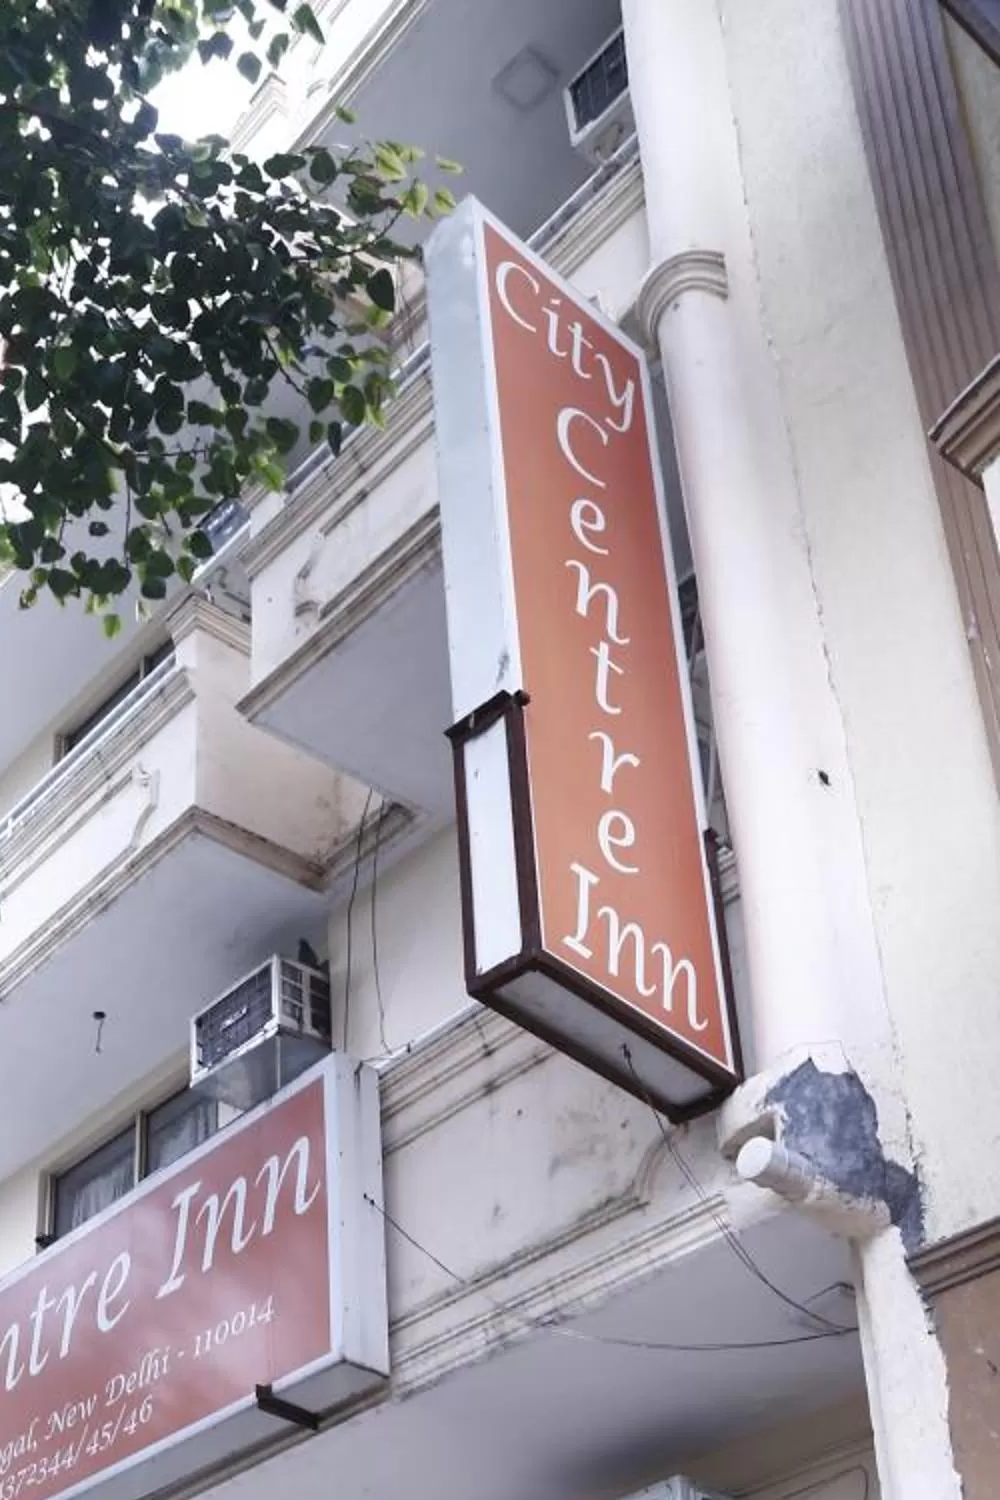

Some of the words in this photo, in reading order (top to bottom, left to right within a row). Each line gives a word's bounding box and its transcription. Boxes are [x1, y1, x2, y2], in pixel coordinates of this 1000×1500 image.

[496, 260, 637, 434] City
[557, 406, 641, 875] Centre
[562, 862, 709, 1032] Inn
[155, 1135, 321, 1299] Inn
[44, 1393, 98, 1441] New
[105, 1346, 169, 1407] Delhi
[193, 1294, 275, 1360] 110014
